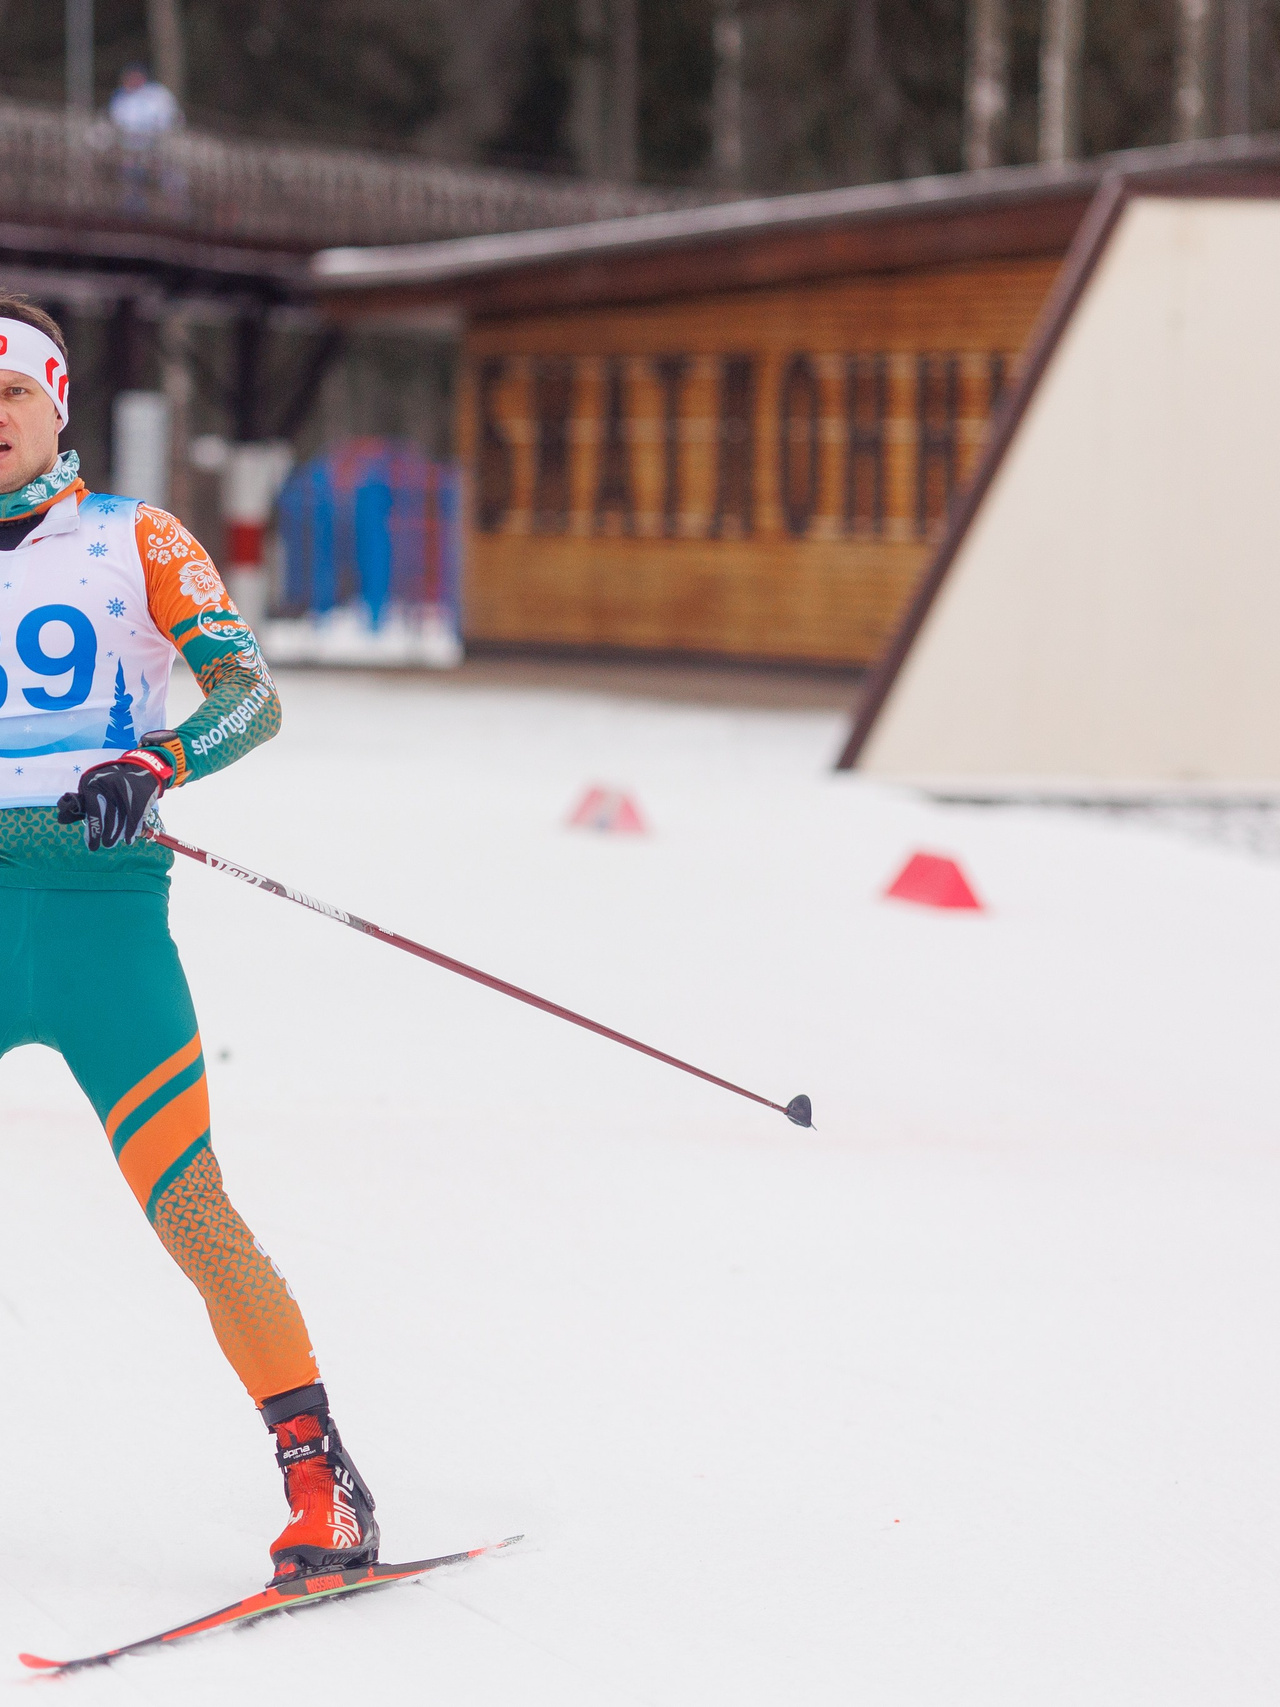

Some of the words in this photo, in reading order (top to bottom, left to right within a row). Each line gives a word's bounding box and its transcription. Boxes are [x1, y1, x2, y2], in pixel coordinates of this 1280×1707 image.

[191, 683, 271, 756] sportgen.ru
[283, 1445, 311, 1459] alpina
[305, 1574, 347, 1595] ROSSIGNOL
